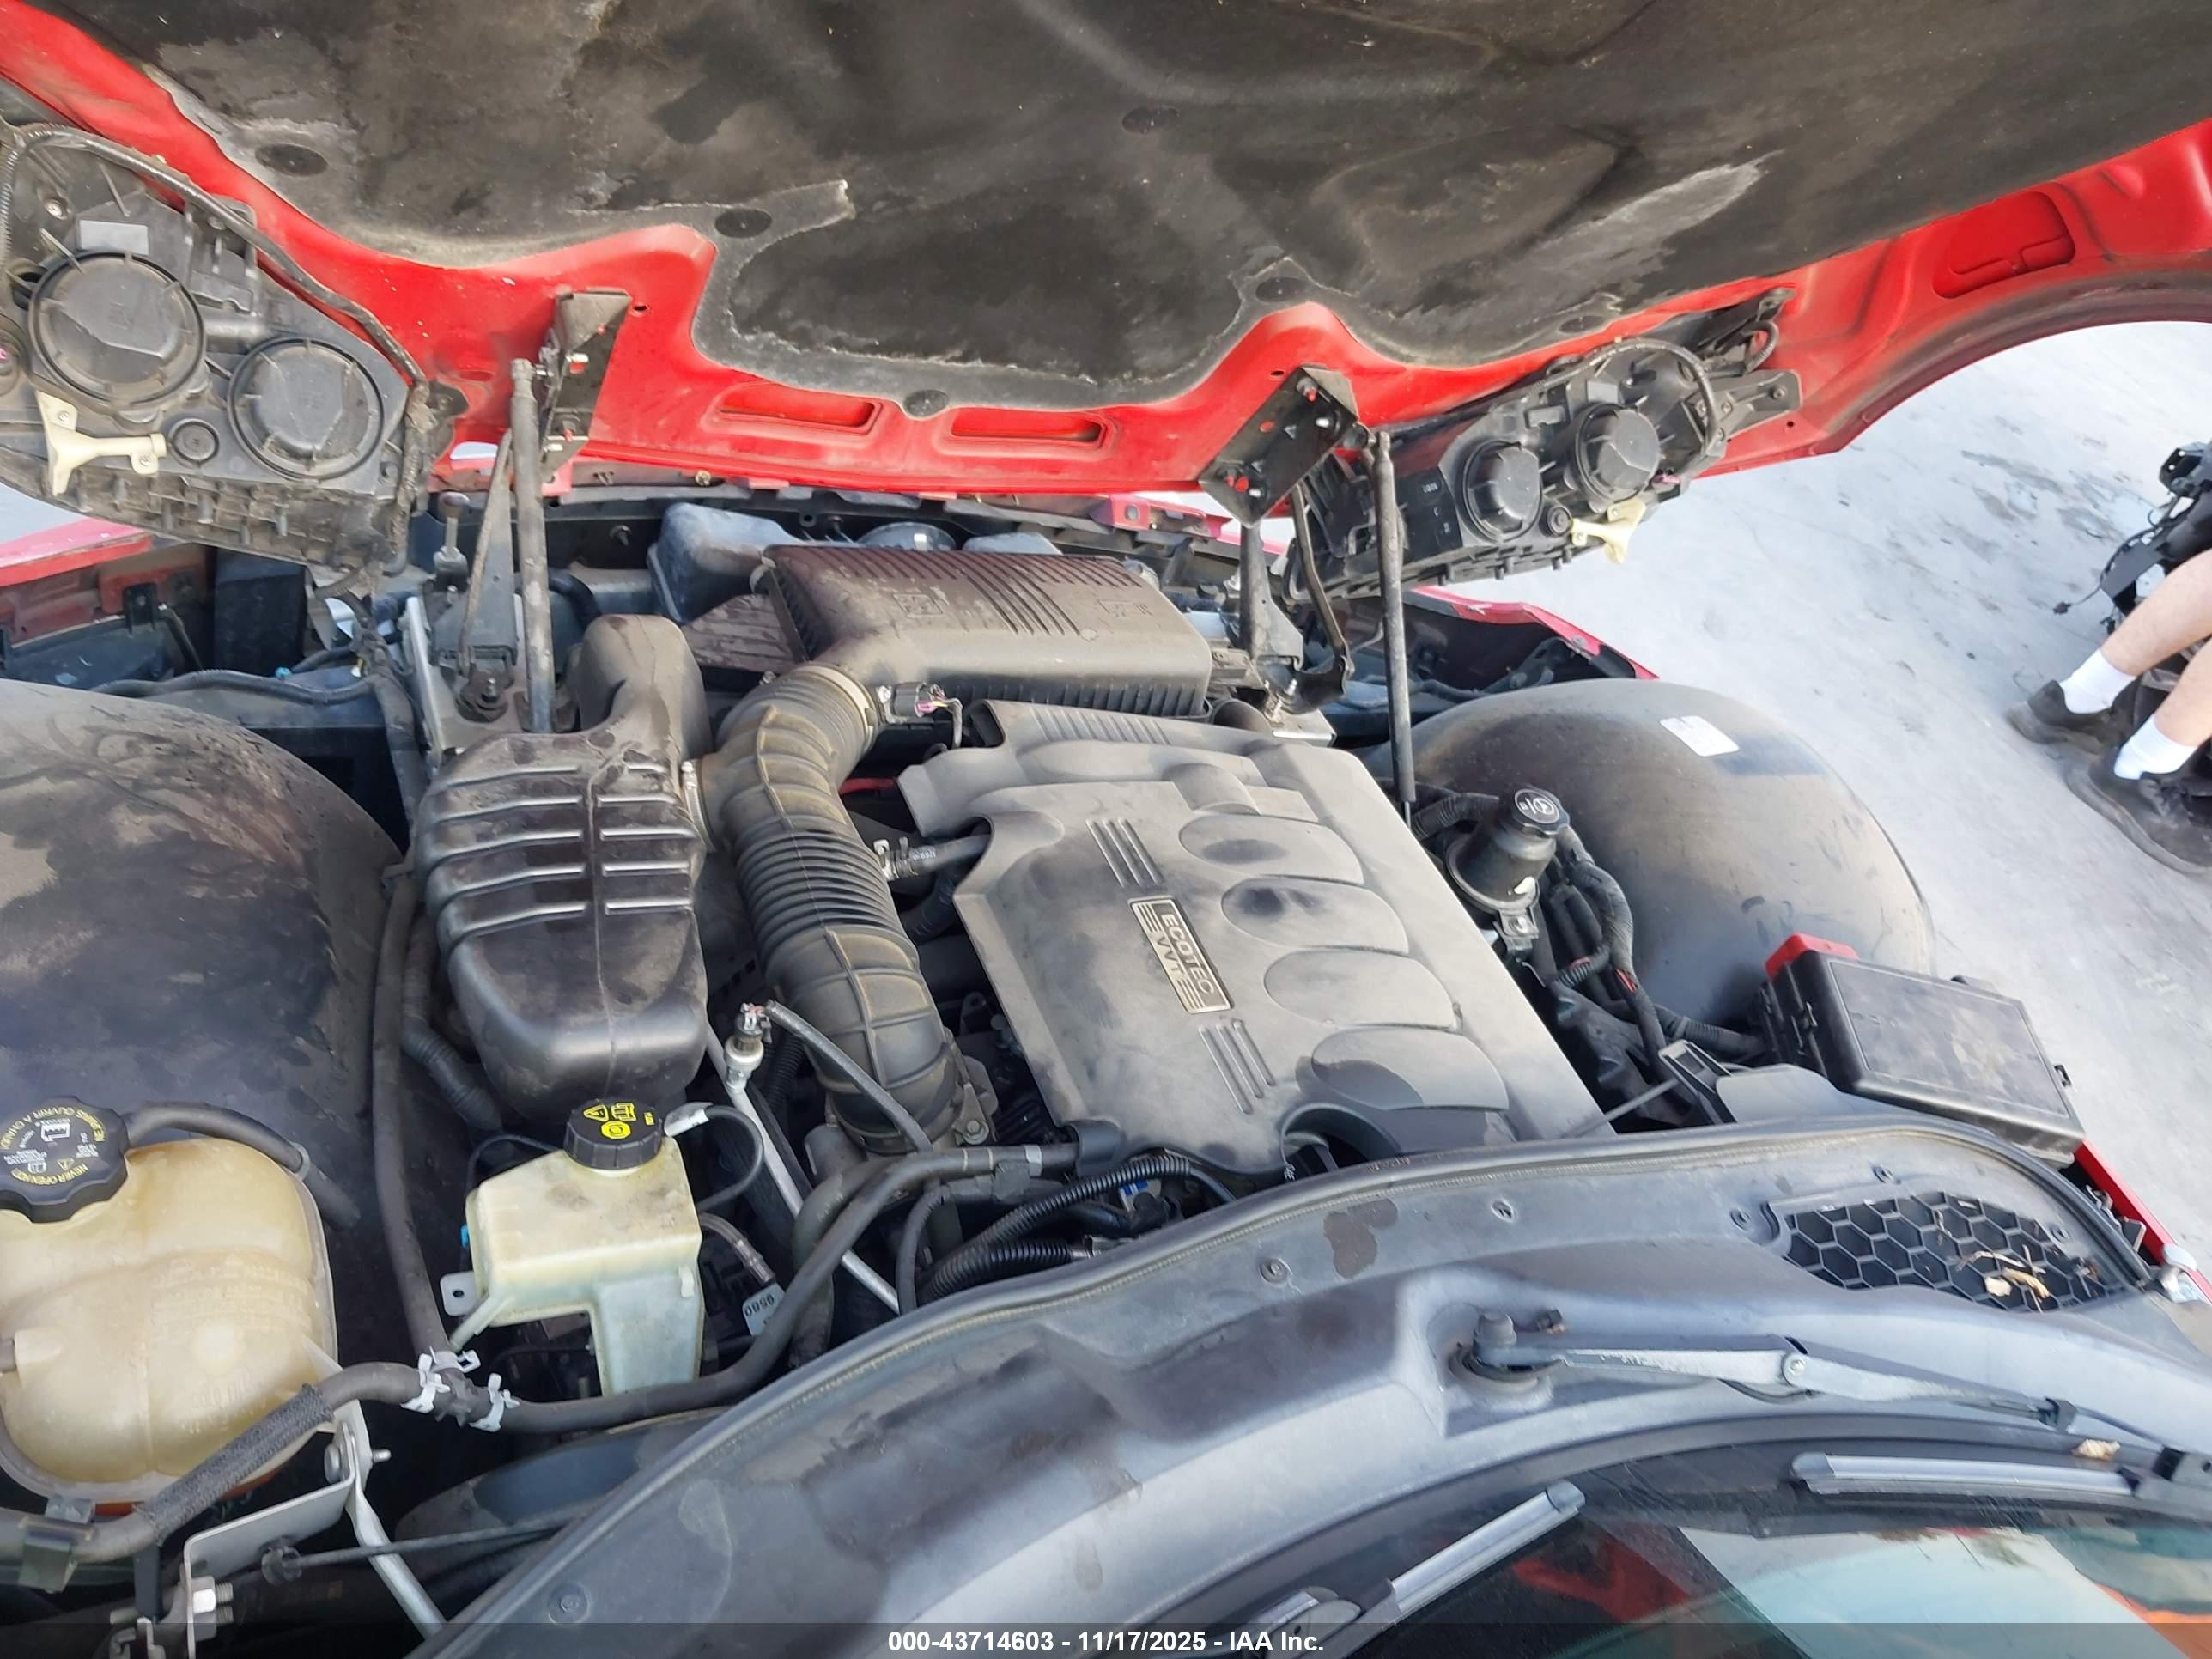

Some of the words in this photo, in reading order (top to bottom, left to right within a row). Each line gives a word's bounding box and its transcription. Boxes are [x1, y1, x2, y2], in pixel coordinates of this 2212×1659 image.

[1157, 937, 1182, 974] VVT
[1161, 914, 1213, 994] ECOTEC
[33, 1107, 75, 1119] OUVRIR
[58, 1163, 88, 1183] NEVER
